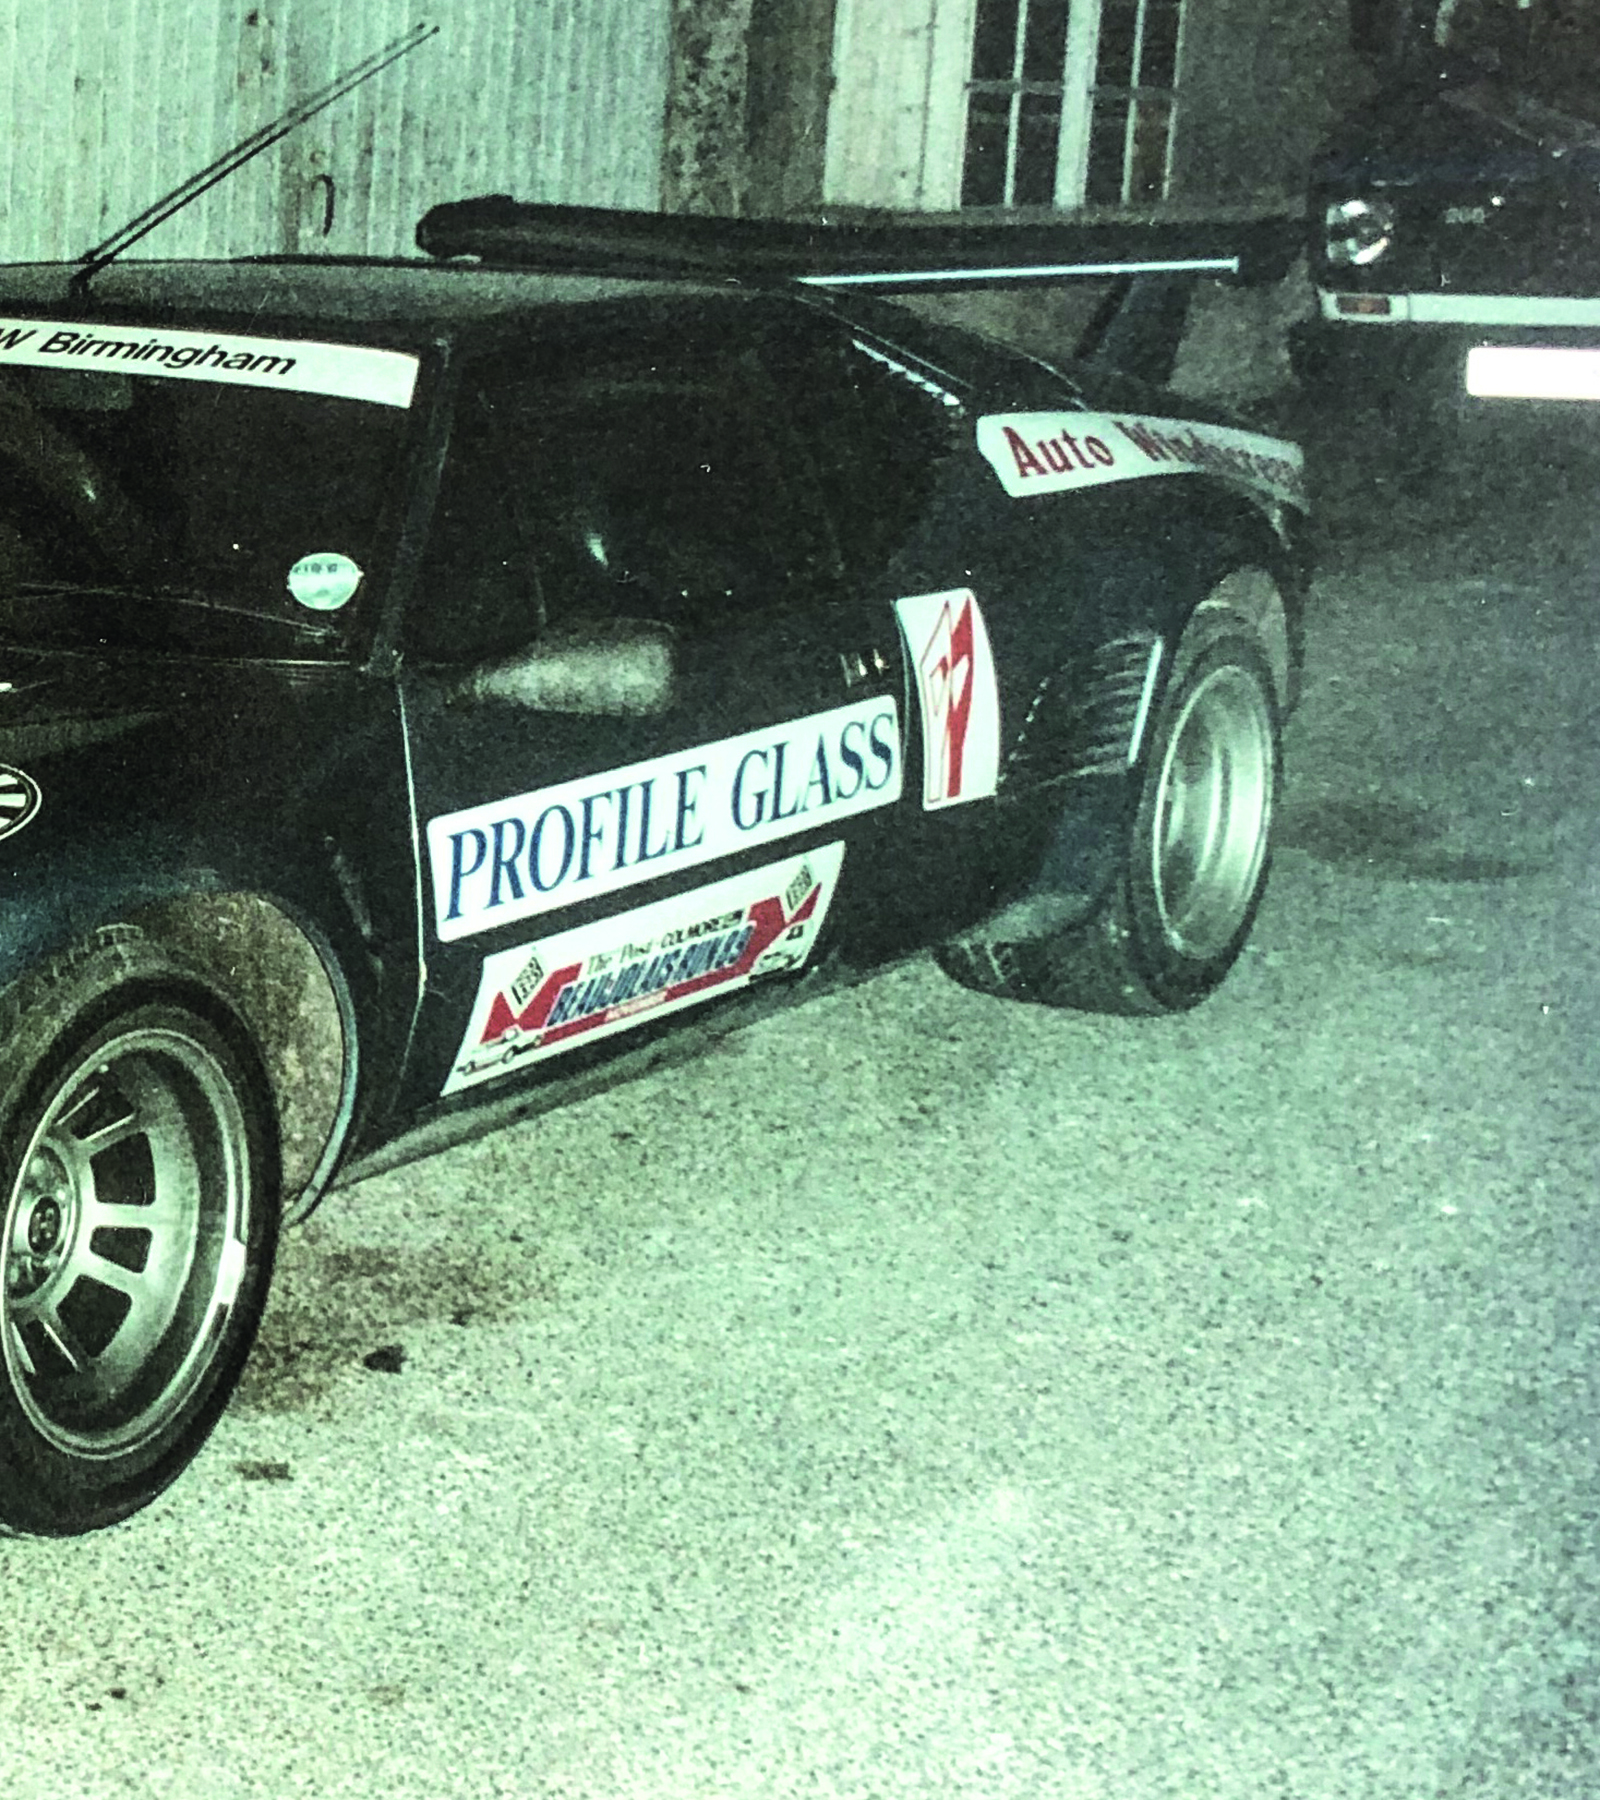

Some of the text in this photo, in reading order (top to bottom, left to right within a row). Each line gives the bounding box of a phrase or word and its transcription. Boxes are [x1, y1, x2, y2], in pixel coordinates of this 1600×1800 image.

[37, 330, 297, 376] Birmingham
[1002, 425, 1116, 478] Auto
[443, 712, 896, 923] PROFILE GLASS
